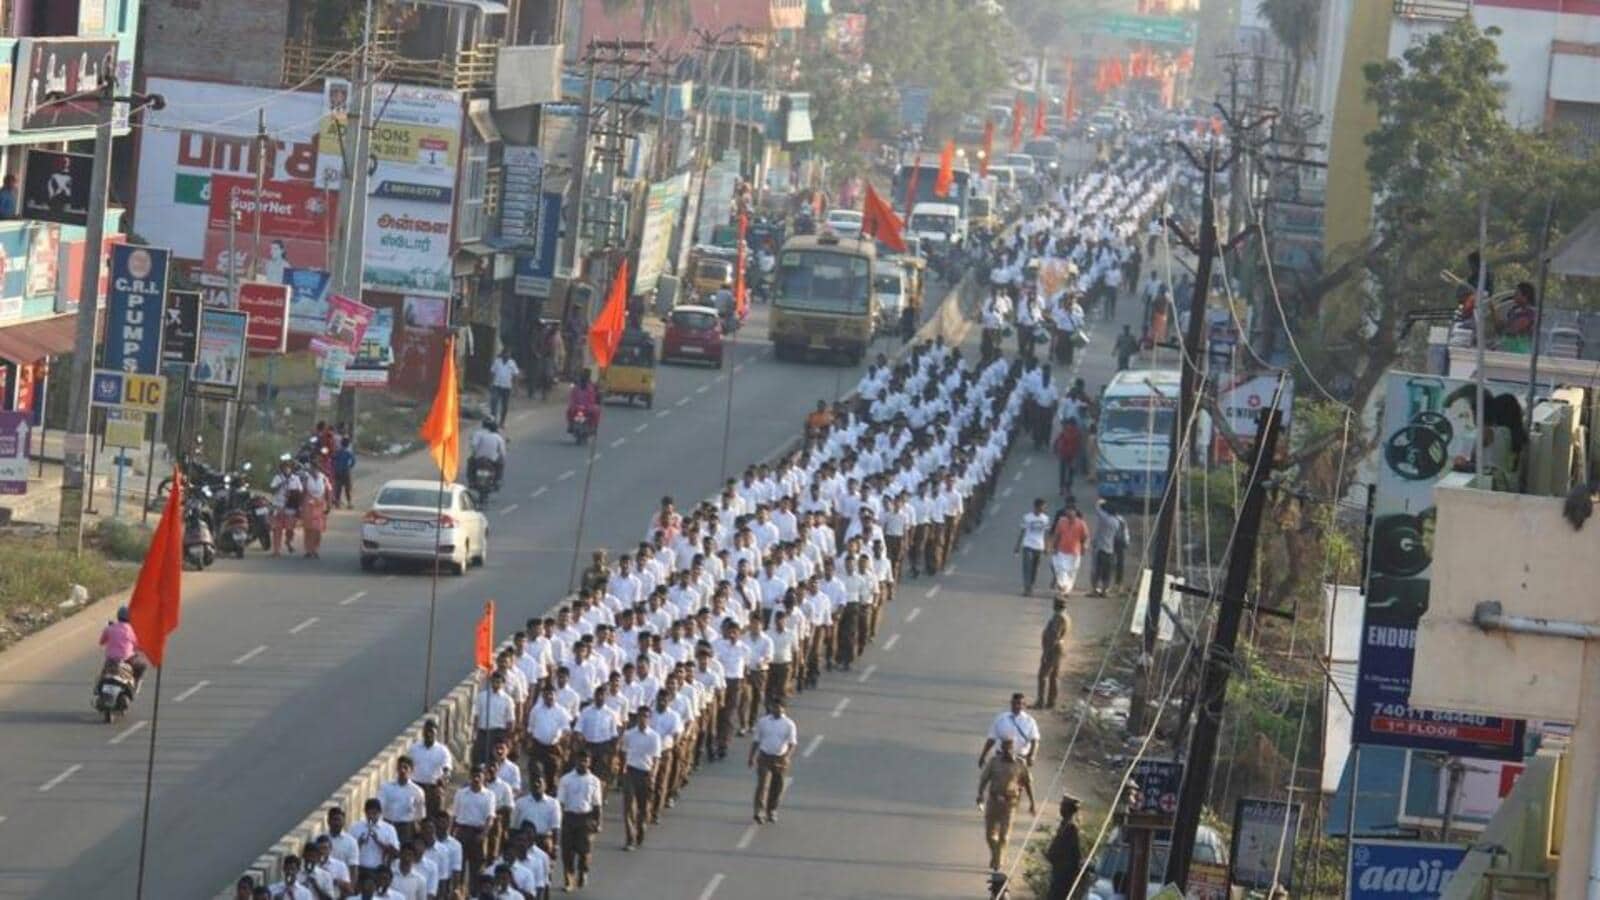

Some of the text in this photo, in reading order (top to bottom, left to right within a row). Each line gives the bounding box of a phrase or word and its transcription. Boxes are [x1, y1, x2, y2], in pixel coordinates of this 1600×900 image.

[231, 197, 292, 215] SuprNet
[115, 277, 160, 294] C.R.I.
[122, 294, 145, 373] PUMPS
[126, 377, 161, 405] LIC
[1407, 723, 1458, 737] FLOOR
